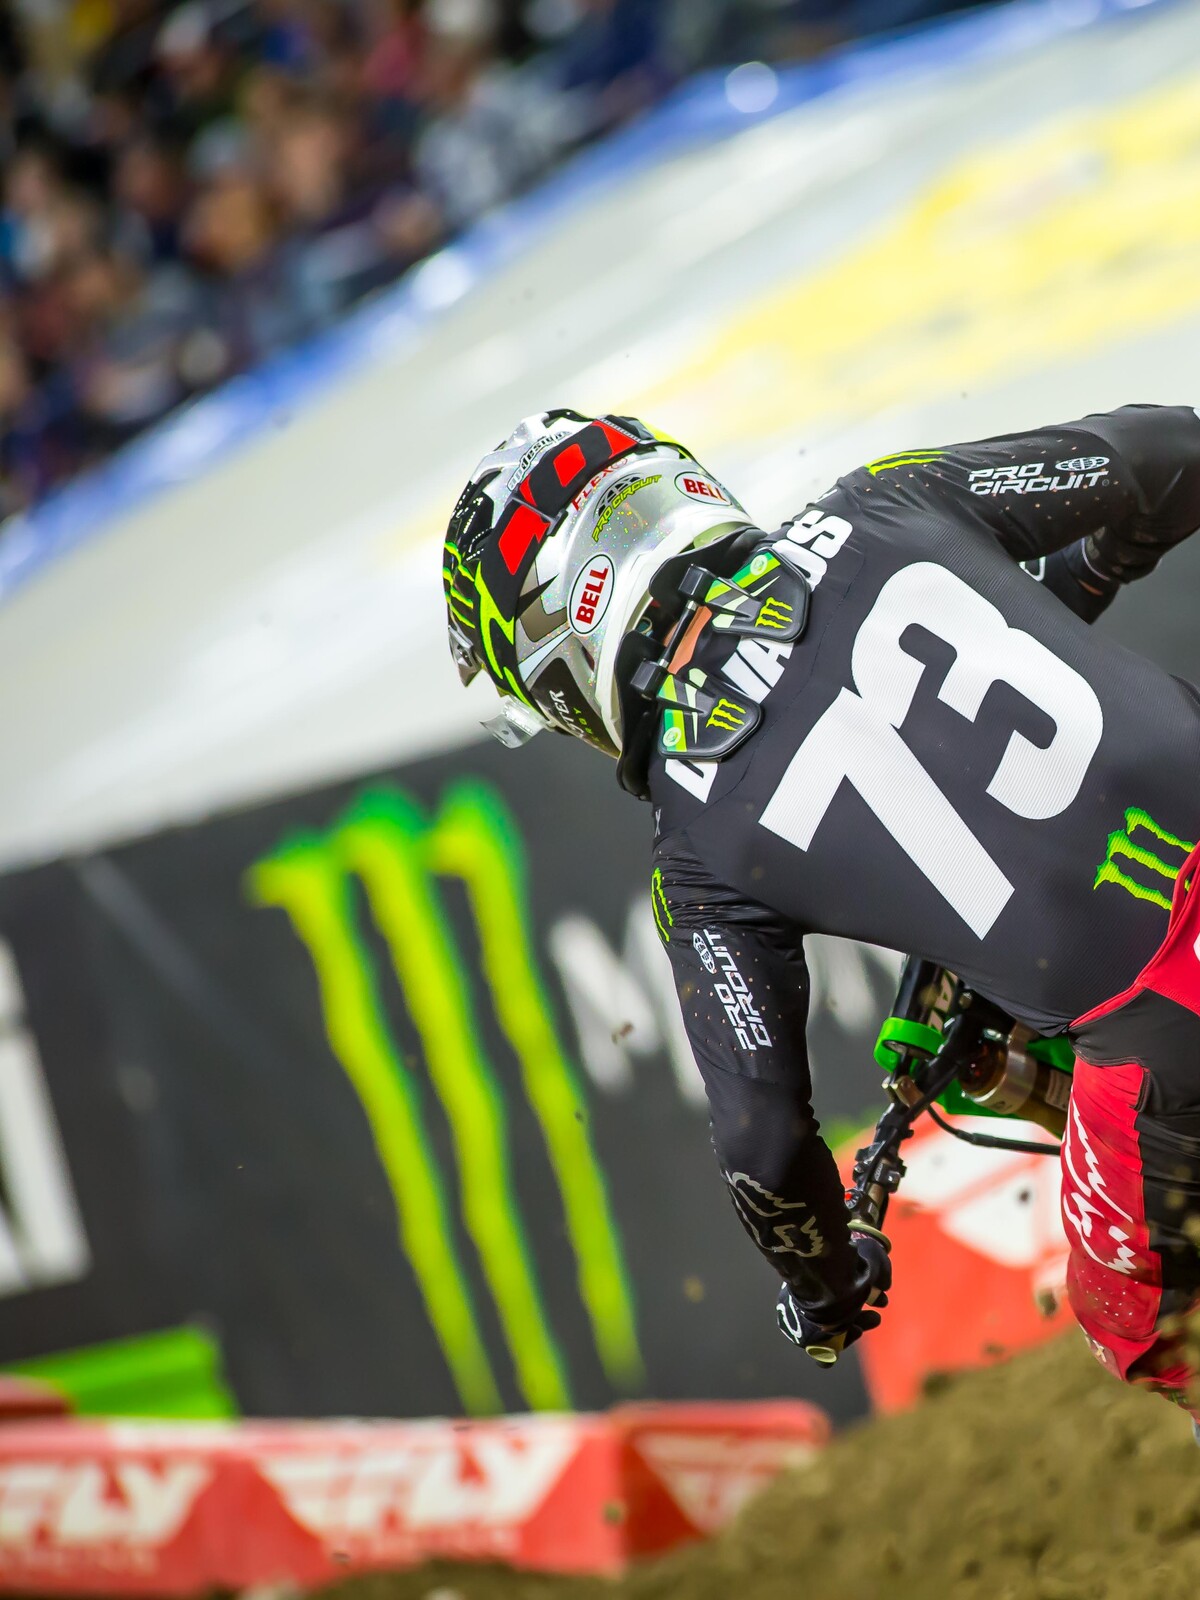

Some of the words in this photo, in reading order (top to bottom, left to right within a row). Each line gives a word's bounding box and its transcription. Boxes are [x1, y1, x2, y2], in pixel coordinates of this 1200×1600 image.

[683, 477, 728, 502] BELL
[968, 463, 1044, 482] PRO
[969, 471, 1109, 496] CIRCUIT
[591, 507, 613, 543] PRO
[612, 474, 662, 510] CIRCUIT
[575, 567, 609, 625] BELL
[758, 562, 1103, 940] 73
[703, 929, 773, 1048] CIRCUIT
[714, 983, 757, 1051] PRO
